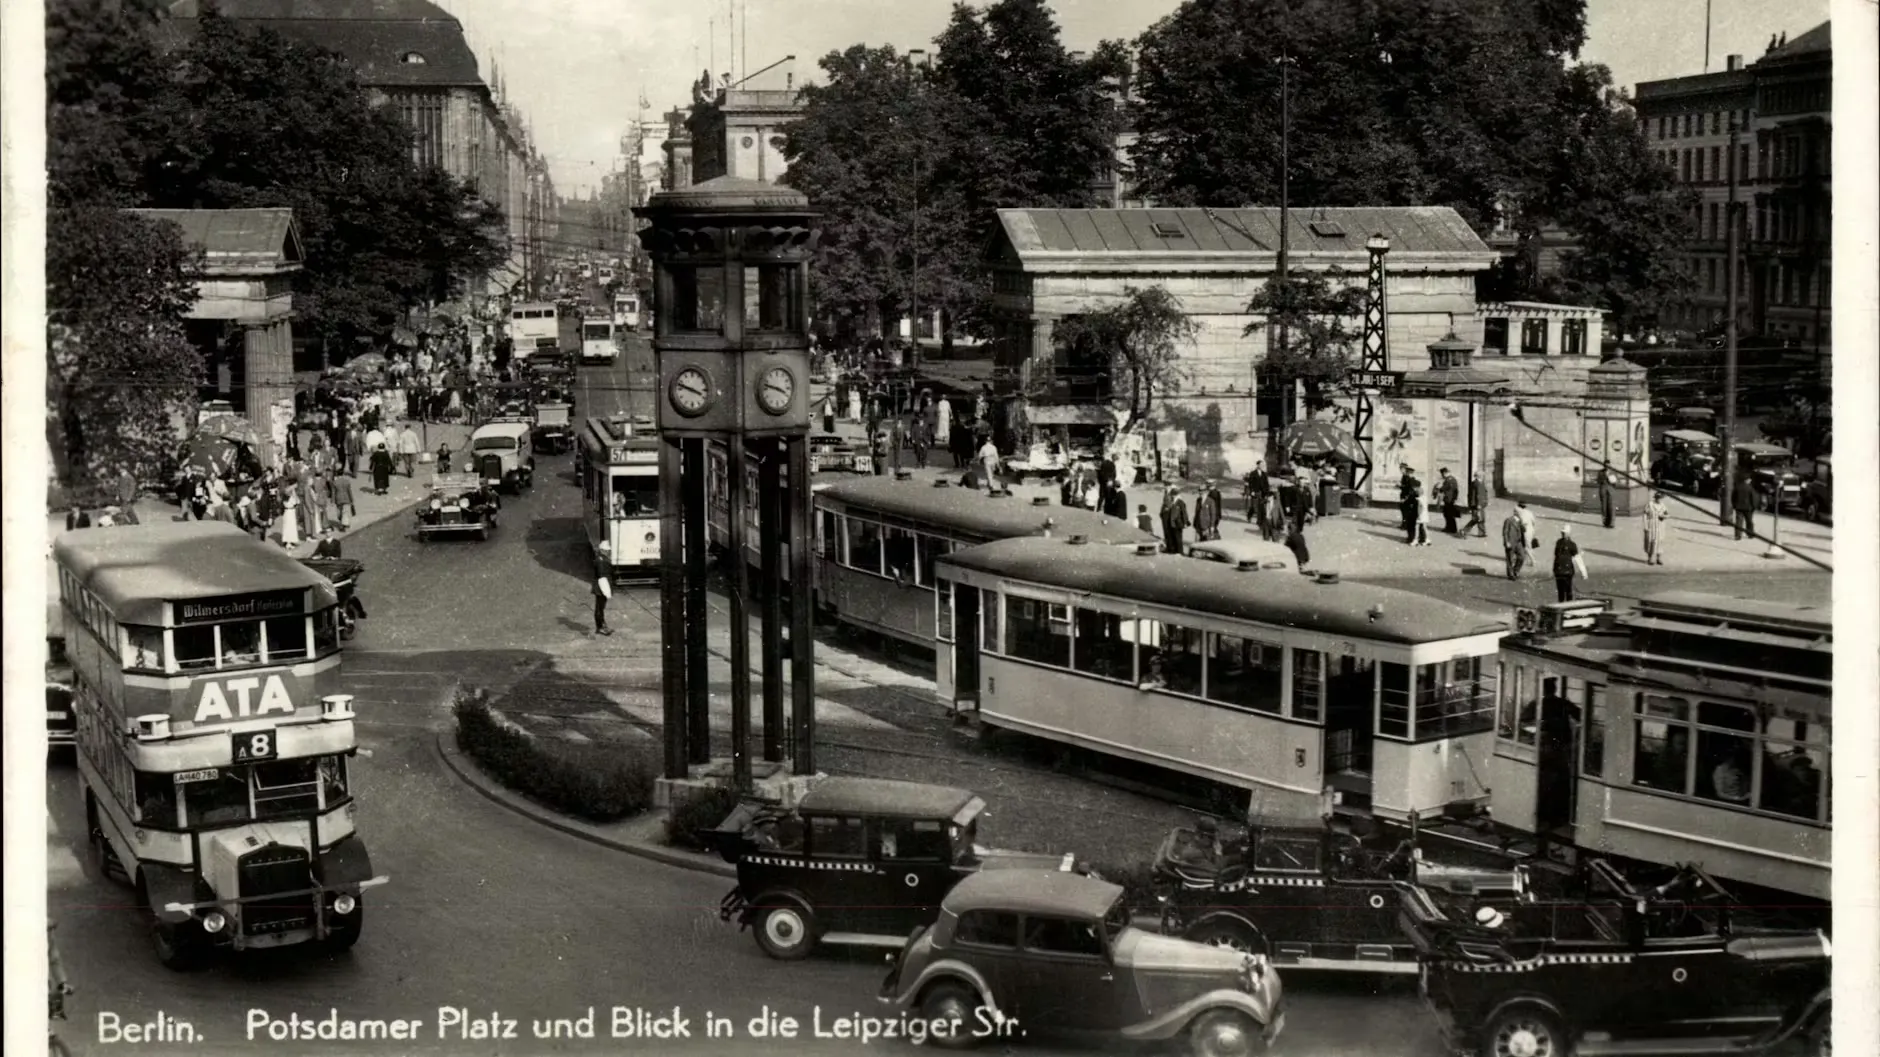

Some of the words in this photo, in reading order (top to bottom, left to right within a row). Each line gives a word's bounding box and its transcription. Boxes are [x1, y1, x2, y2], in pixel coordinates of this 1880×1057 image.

[183, 598, 254, 618] Wilmersdorf
[194, 674, 295, 722] ATA
[250, 733, 270, 757] 8
